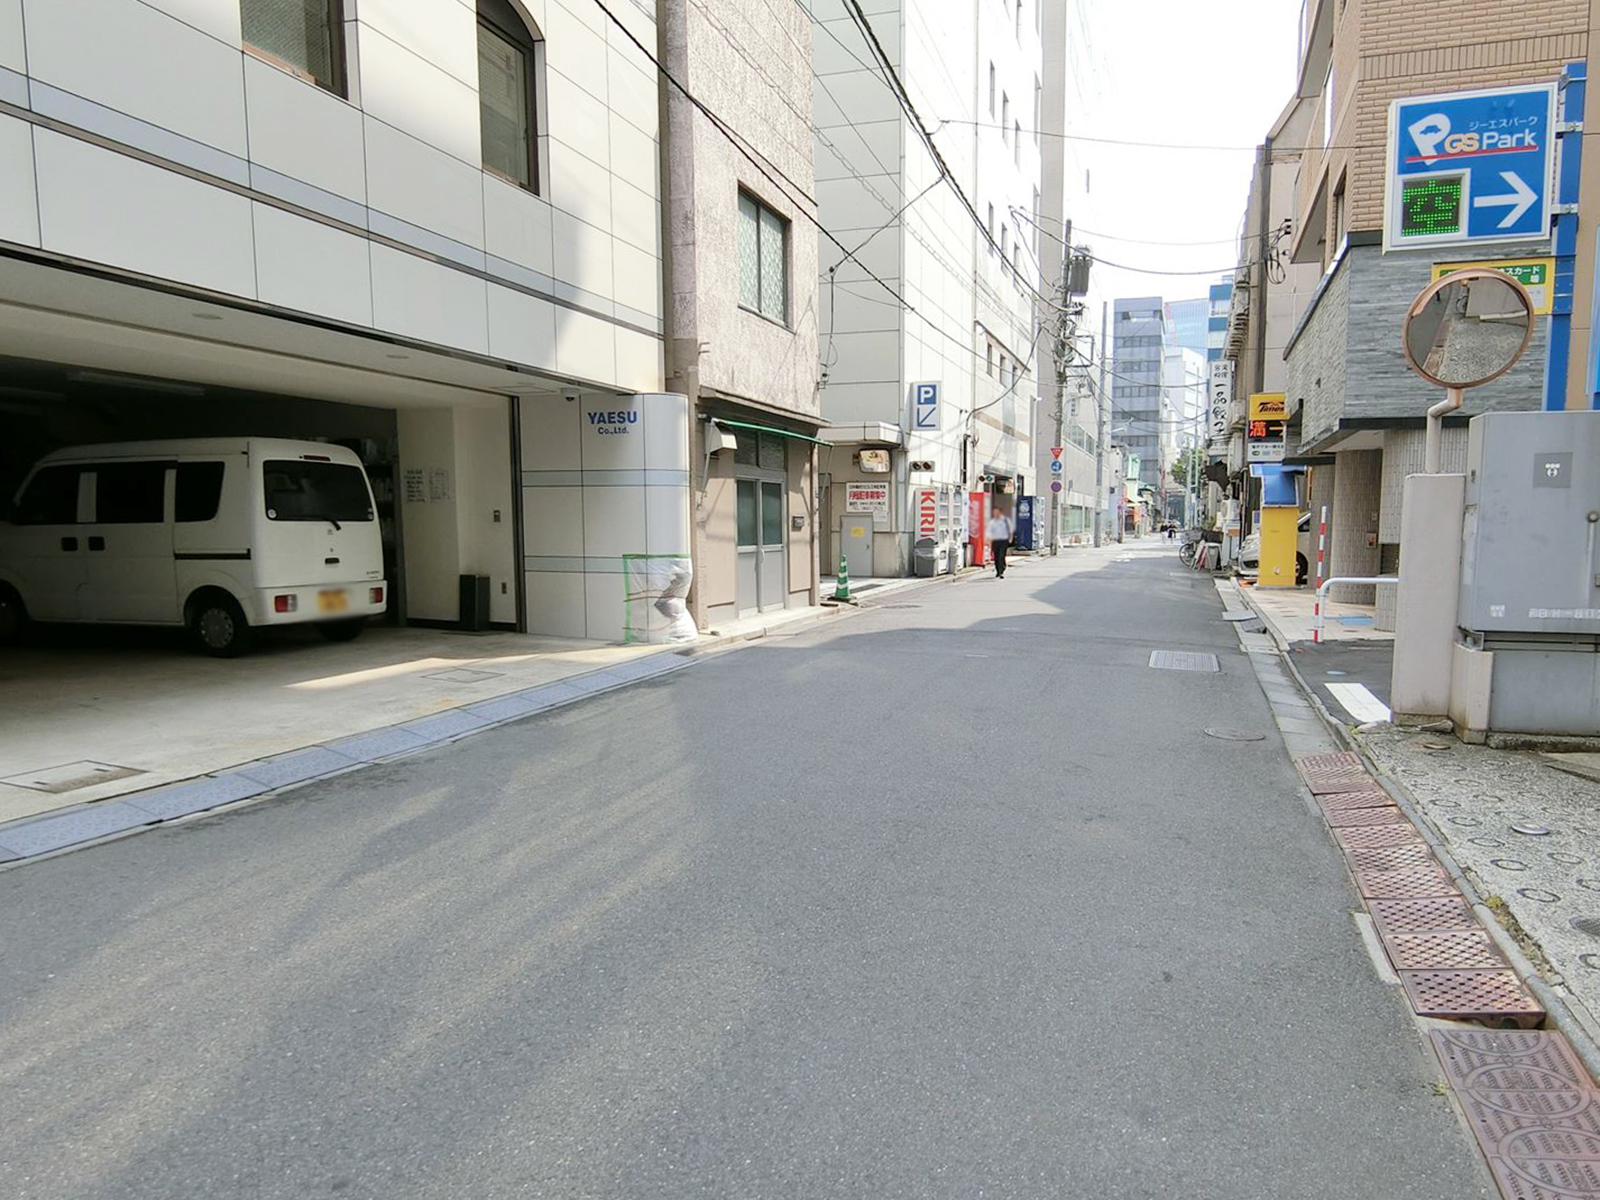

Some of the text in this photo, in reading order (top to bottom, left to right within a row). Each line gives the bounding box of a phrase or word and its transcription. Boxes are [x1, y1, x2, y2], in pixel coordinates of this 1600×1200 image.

[1469, 116, 1538, 131] ジーエスパーク
[920, 386, 934, 402] P
[587, 411, 637, 424] YAESU
[920, 491, 936, 537] KIRI
